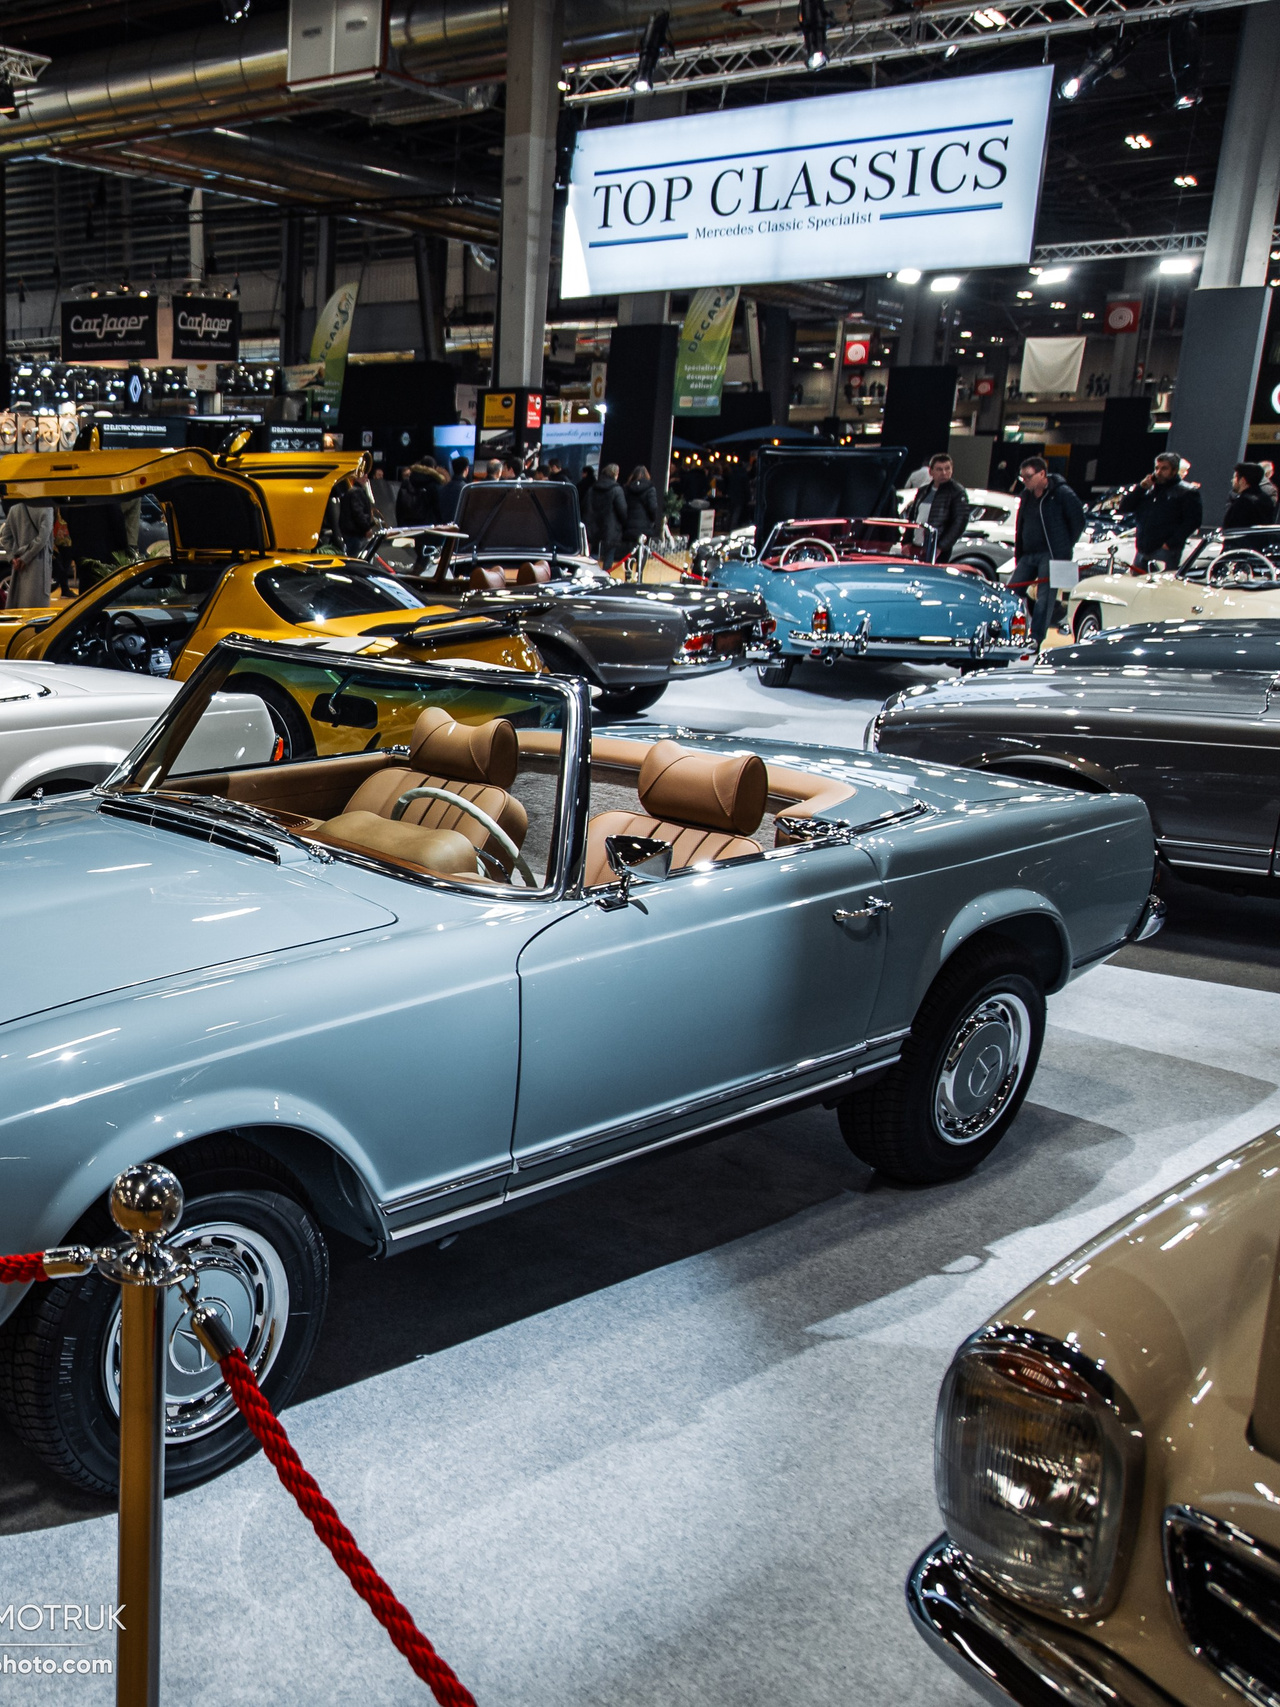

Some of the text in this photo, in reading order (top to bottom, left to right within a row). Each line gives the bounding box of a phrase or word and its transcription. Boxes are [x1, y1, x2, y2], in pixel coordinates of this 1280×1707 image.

[593, 135, 1011, 230] TOP CLASSICS
[695, 211, 872, 240] Mercedes Classic Specialist
[70, 313, 149, 339] CarJager
[177, 310, 232, 338] CarJager
